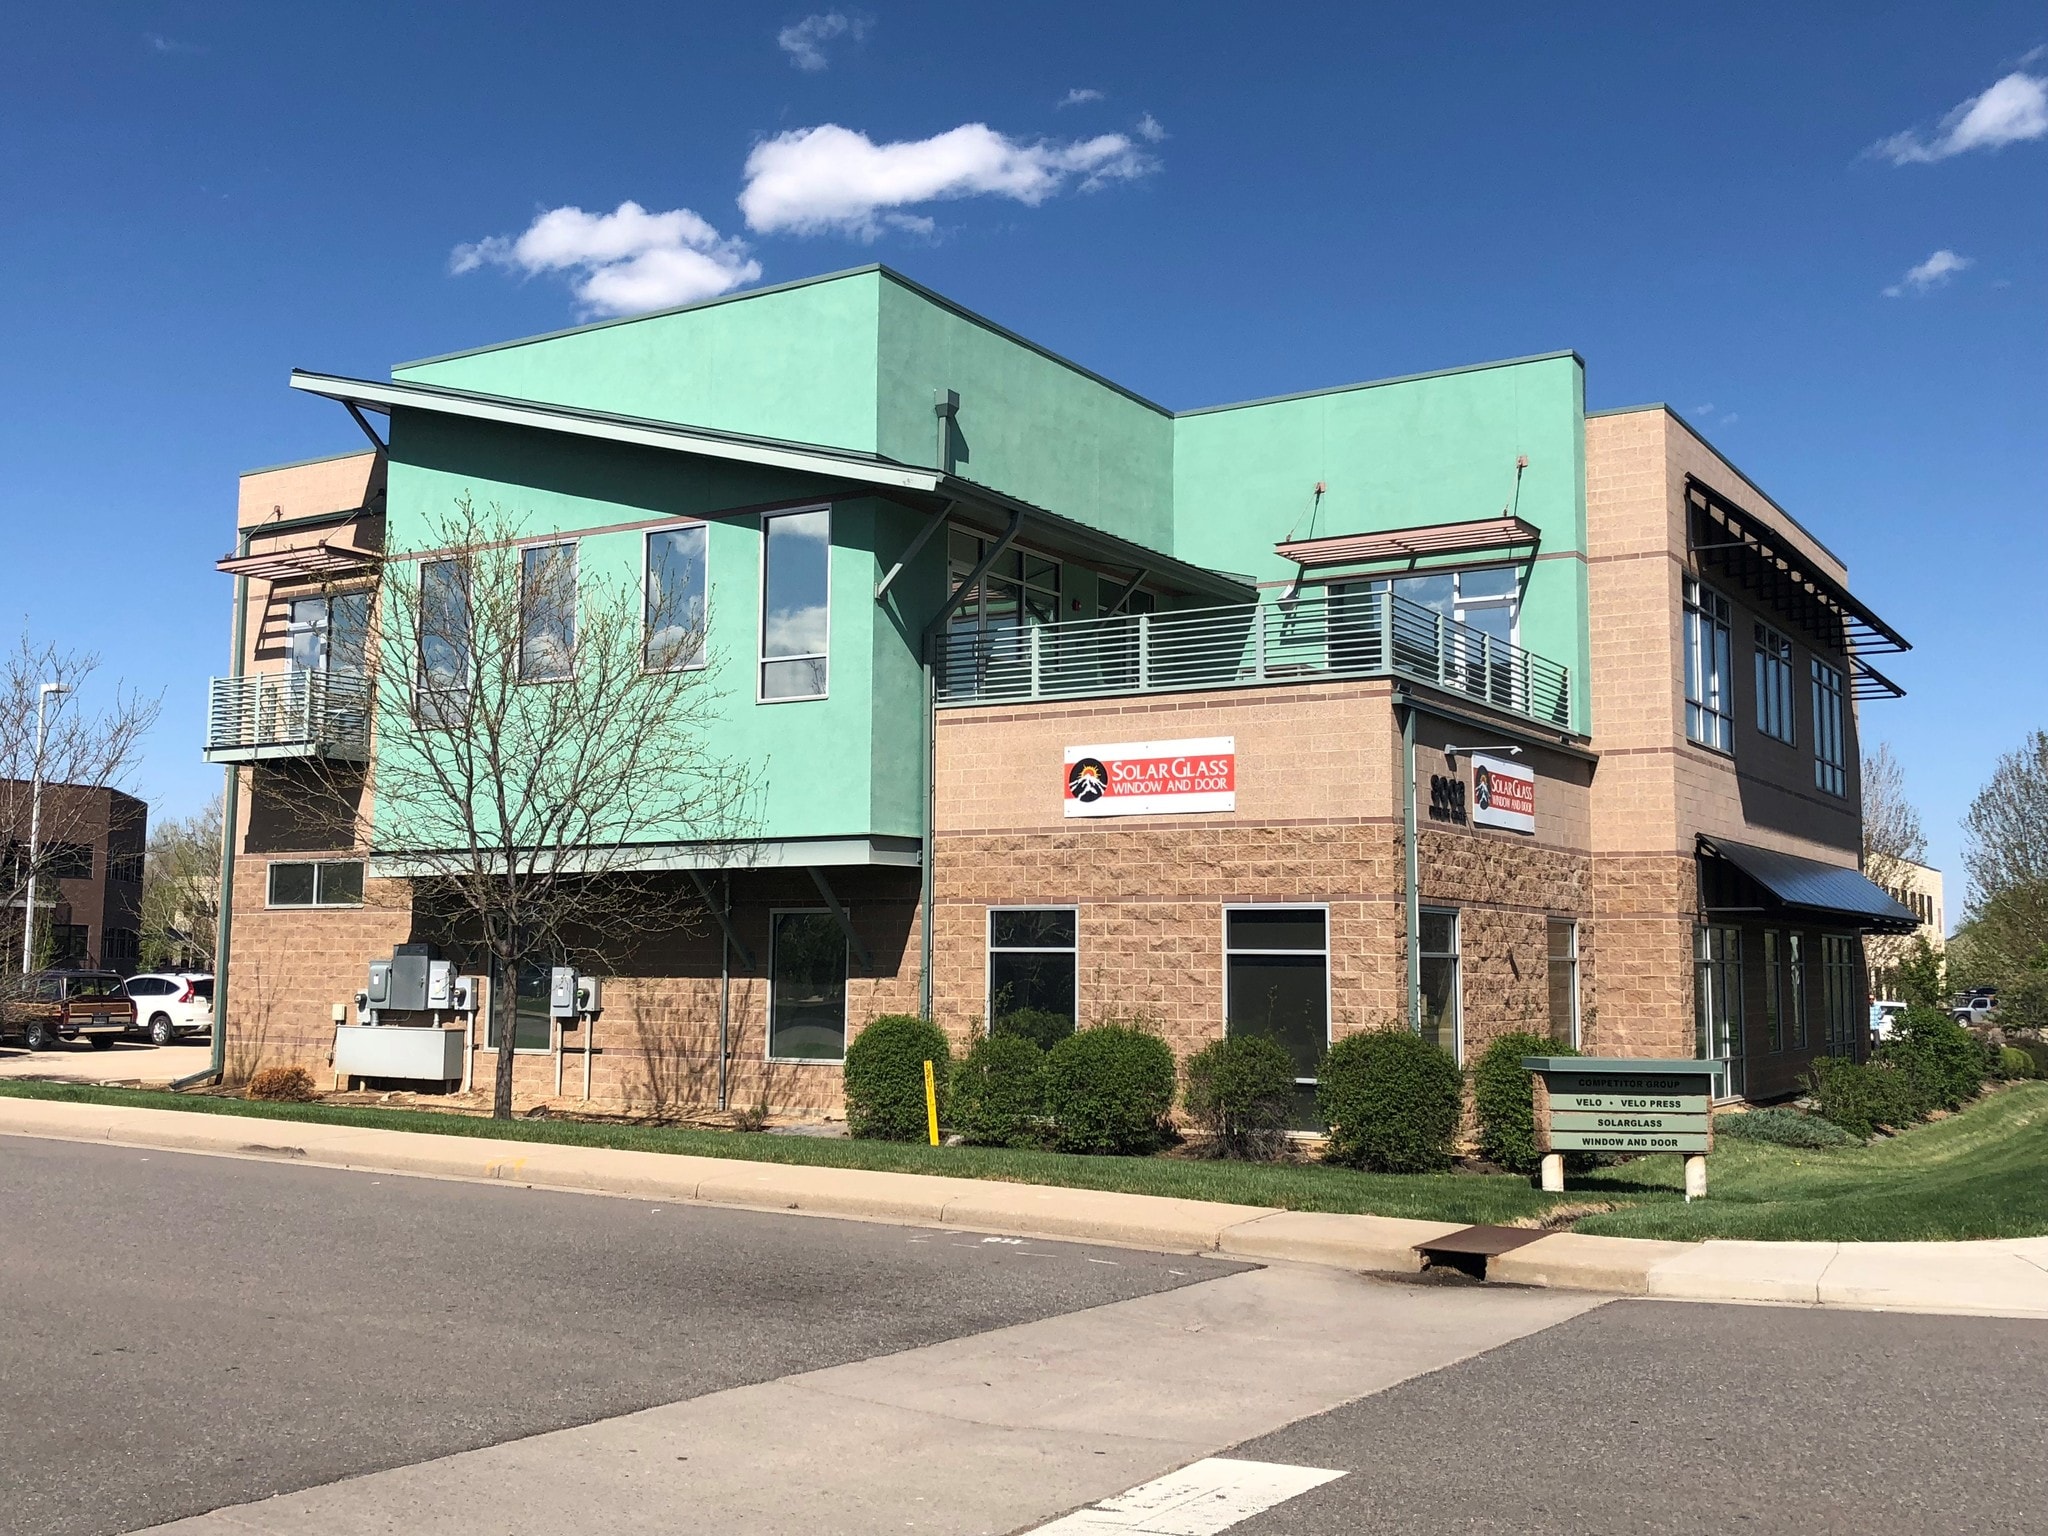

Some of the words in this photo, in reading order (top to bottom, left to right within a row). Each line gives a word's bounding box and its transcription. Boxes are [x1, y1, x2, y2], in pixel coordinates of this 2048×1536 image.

[1112, 782, 1162, 794] WINDOW
[1166, 780, 1191, 792] AND
[1195, 778, 1227, 790] DOOR
[1492, 794, 1510, 807] WINDOW
[1511, 800, 1521, 810] AND
[1579, 1079, 1643, 1088] COMPETITOR
[1576, 1099, 1602, 1107] VELO
[1650, 1100, 1681, 1108] PRESS
[1598, 1119, 1662, 1127] SOLARGLASS
[1582, 1138, 1624, 1146] WINDOW
[1627, 1138, 1647, 1146] AND
